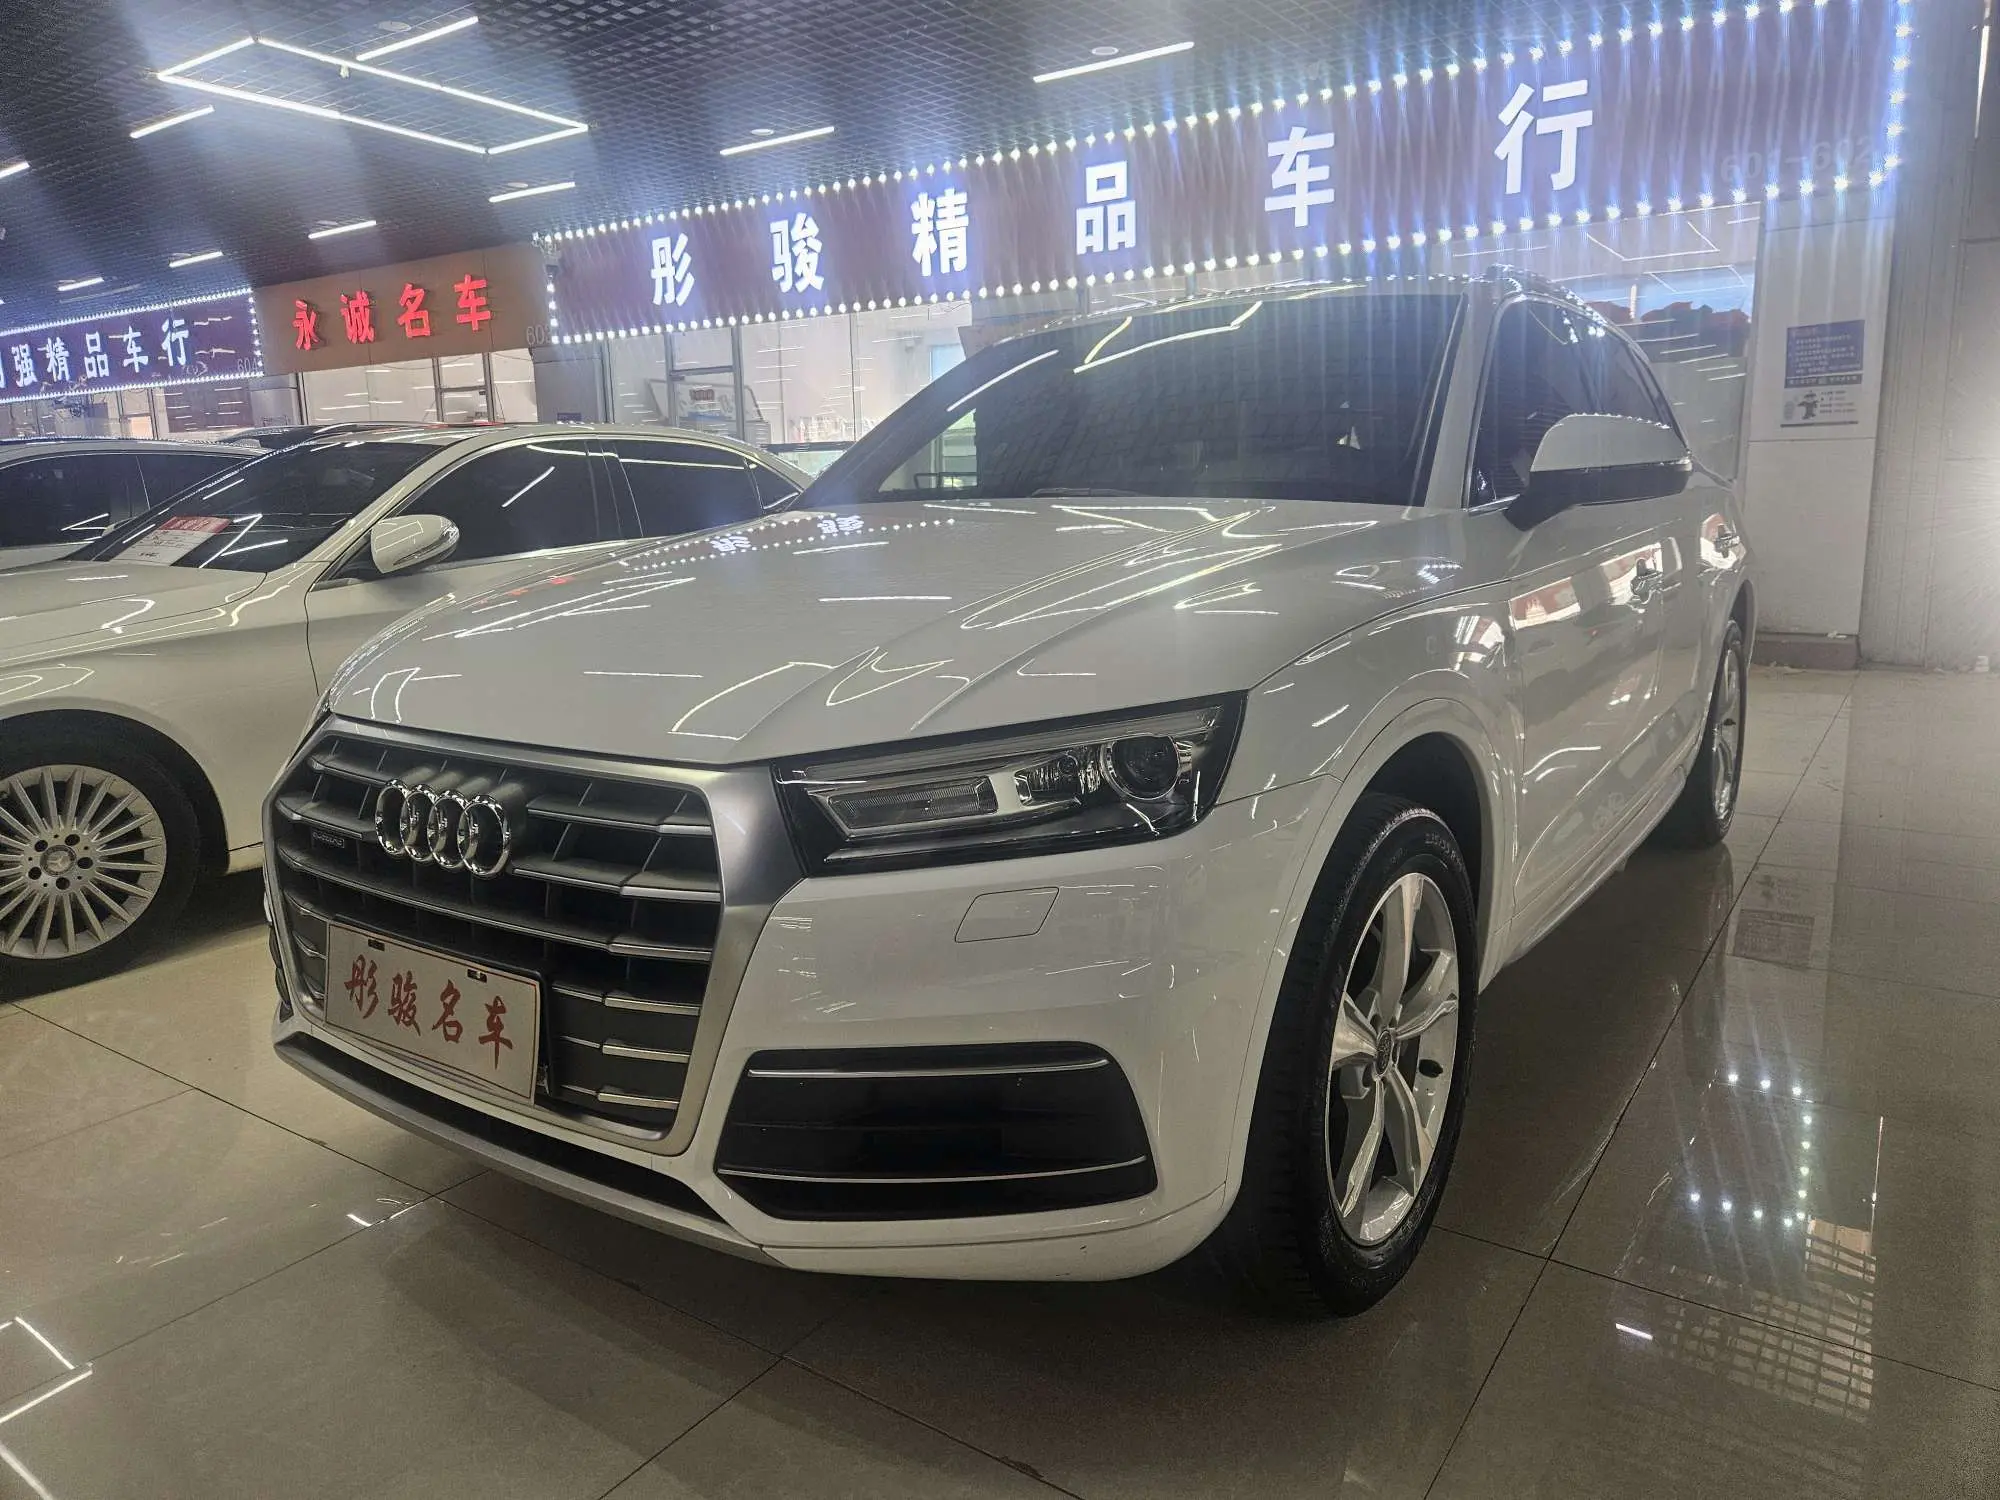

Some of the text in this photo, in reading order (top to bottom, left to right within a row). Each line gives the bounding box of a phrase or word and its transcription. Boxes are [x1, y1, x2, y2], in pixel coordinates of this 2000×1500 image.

[650, 79, 1594, 307] 彤骏精品车行
[0, 317, 190, 389] 强精品车行
[292, 273, 492, 351] 永诚名车
[343, 953, 514, 1071] 彤骏名车
